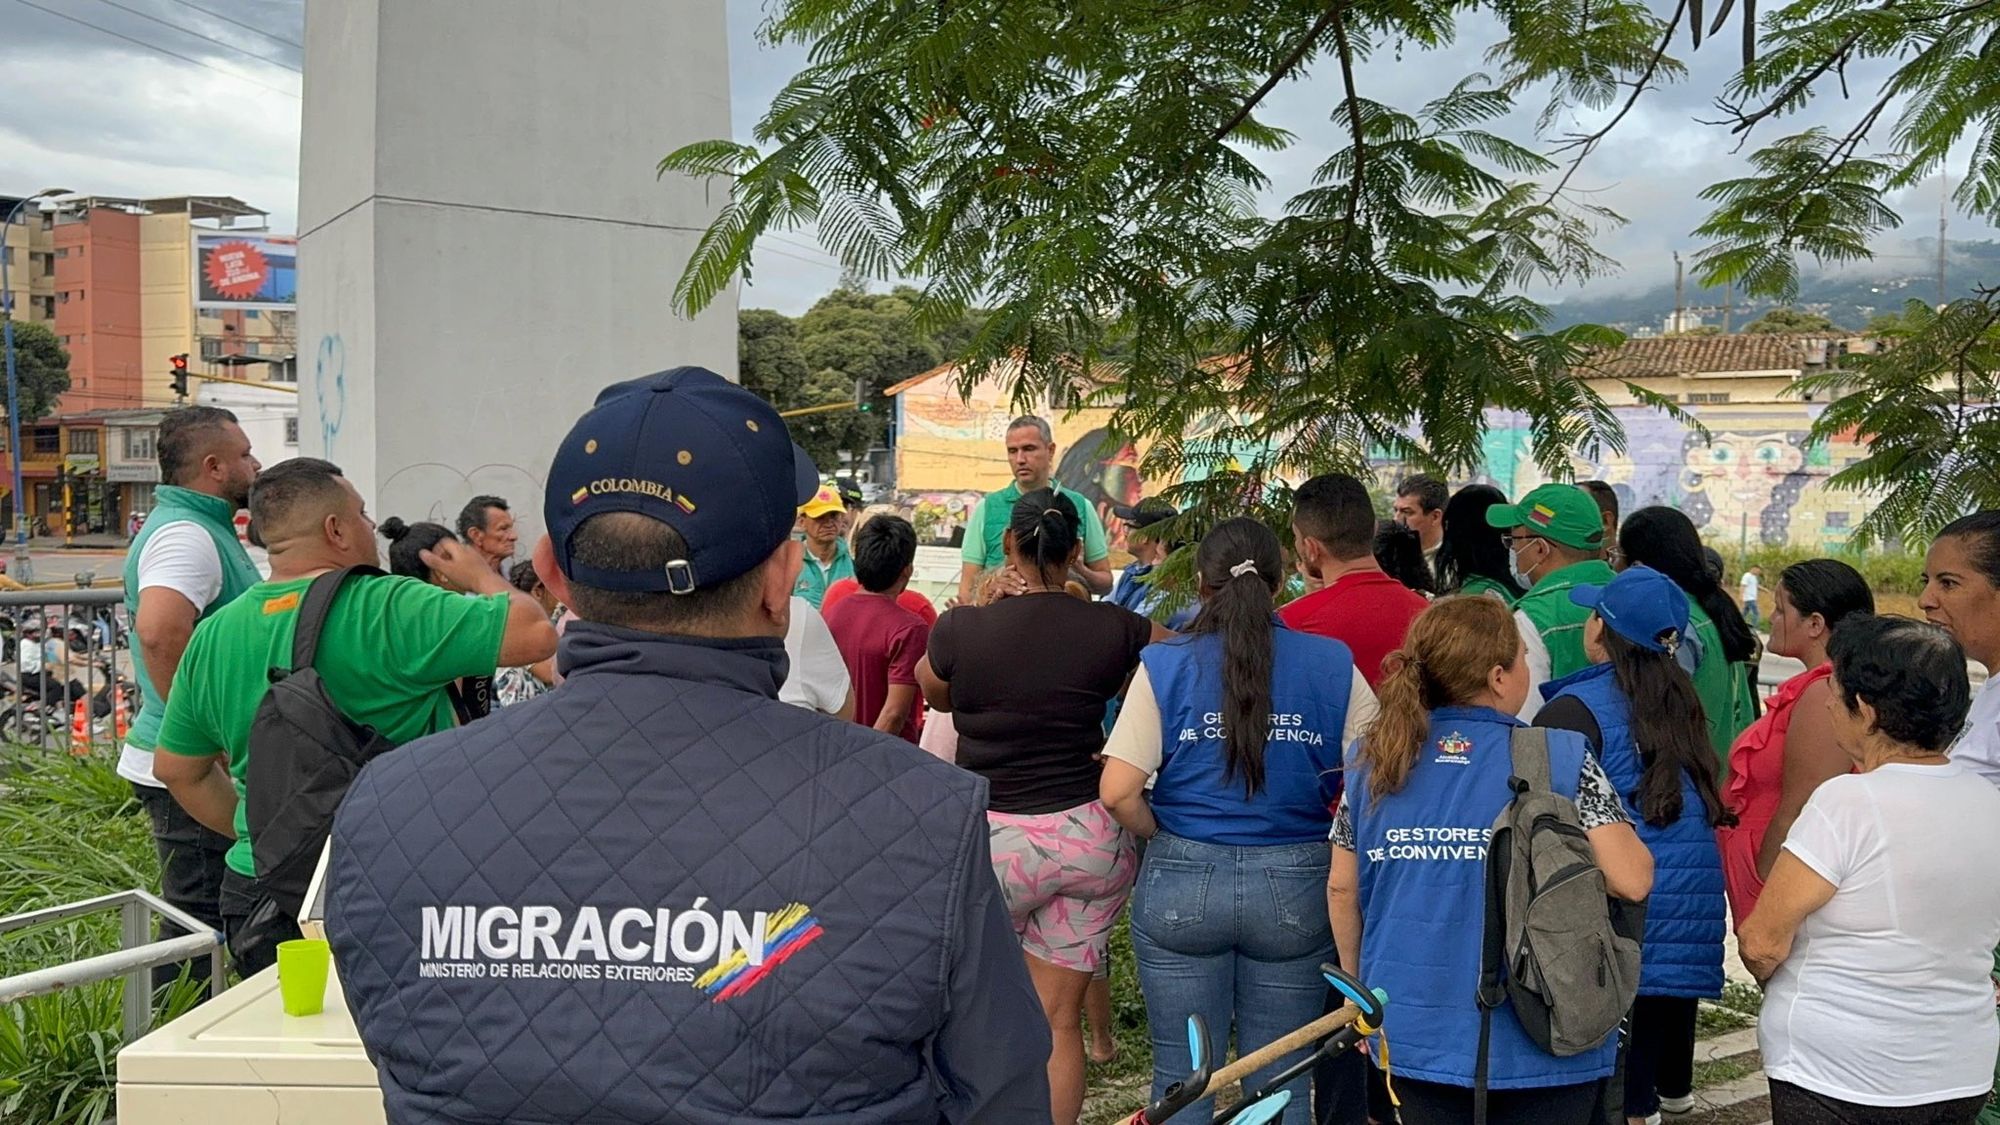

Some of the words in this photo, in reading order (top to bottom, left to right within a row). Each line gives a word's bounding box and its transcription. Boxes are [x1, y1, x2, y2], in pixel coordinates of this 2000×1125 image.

[590, 478, 673, 503] COLOMBIA
[1203, 712, 1303, 726] GERES
[1179, 728, 1198, 741] DE
[1204, 727, 1323, 746] COVENCIA
[1386, 828, 1492, 842] GESTORES
[1367, 848, 1385, 862] DE
[1389, 845, 1487, 860] CONVIVEN
[421, 896, 769, 967] MIGRACIÓN
[419, 962, 486, 978] MINISTERIO
[490, 963, 508, 978] DE
[512, 963, 600, 980] RELACIONES
[605, 965, 695, 983] EXTERIORES
